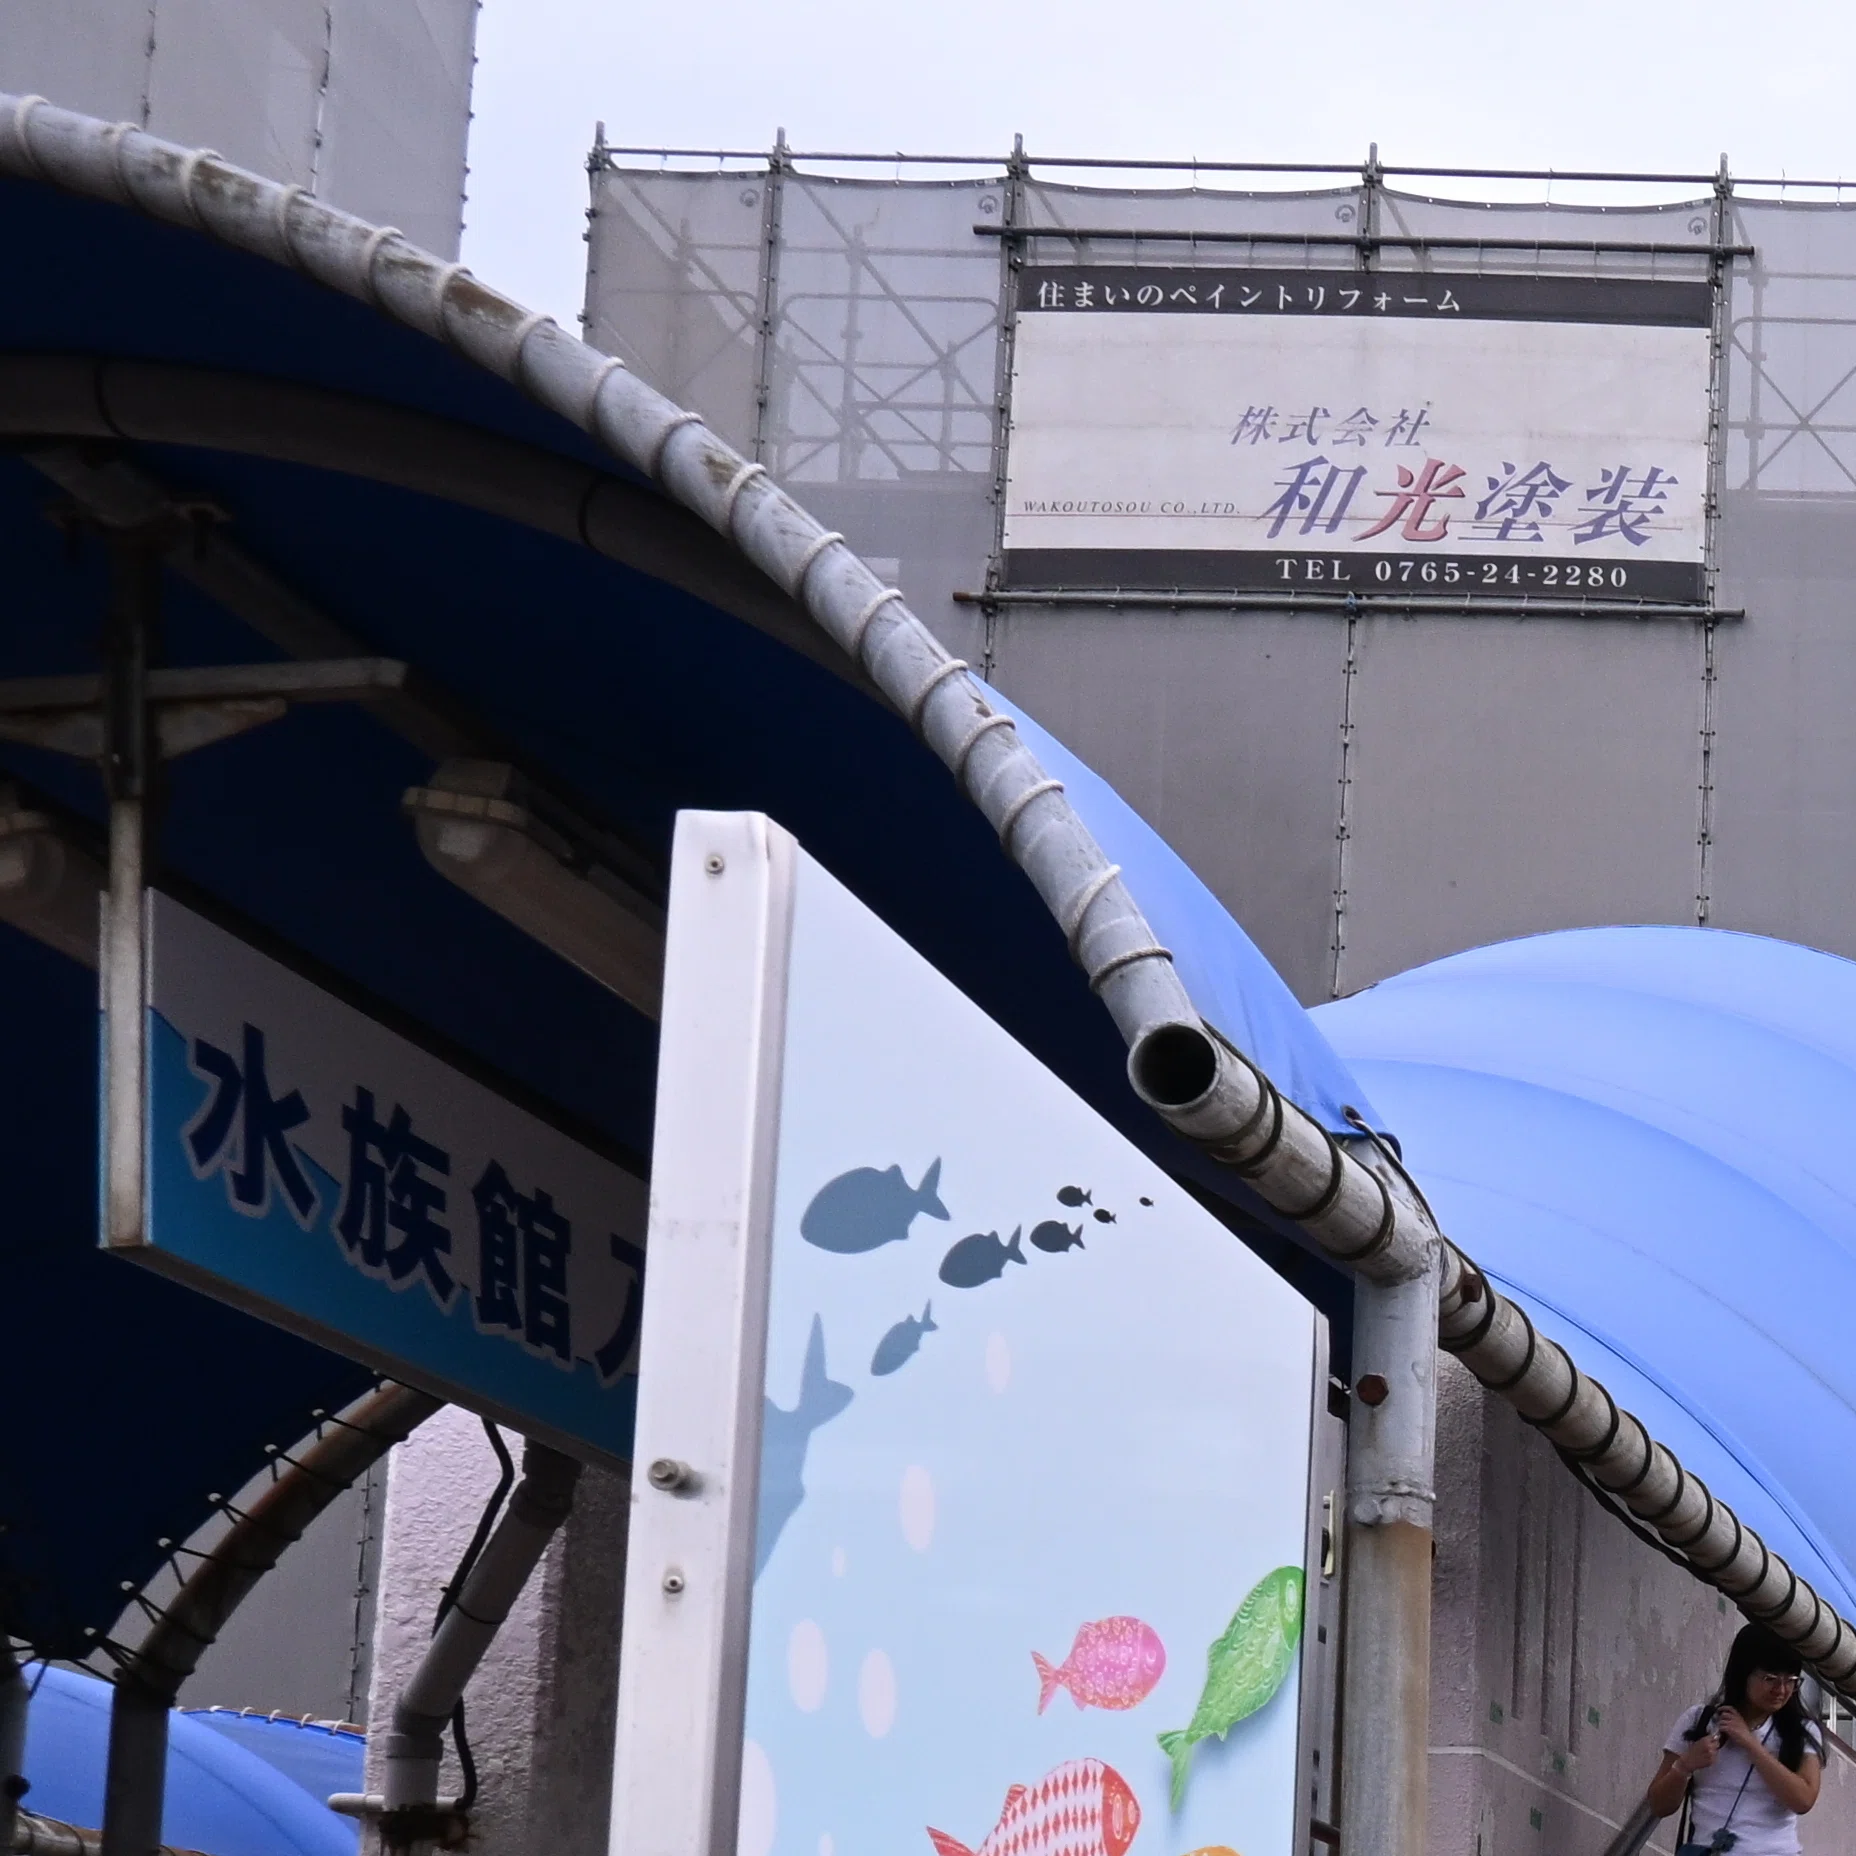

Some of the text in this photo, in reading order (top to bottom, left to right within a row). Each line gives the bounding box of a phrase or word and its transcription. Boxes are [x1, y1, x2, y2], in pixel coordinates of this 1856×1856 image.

[1037, 280, 1462, 314] 住まいのペイントリフォーム
[1229, 404, 1432, 449] 株式会社
[1023, 500, 1152, 514] WAKOUTOSOU
[1261, 454, 1680, 548] 和光塗装
[1275, 556, 1629, 589] TEL 0765-24-2280
